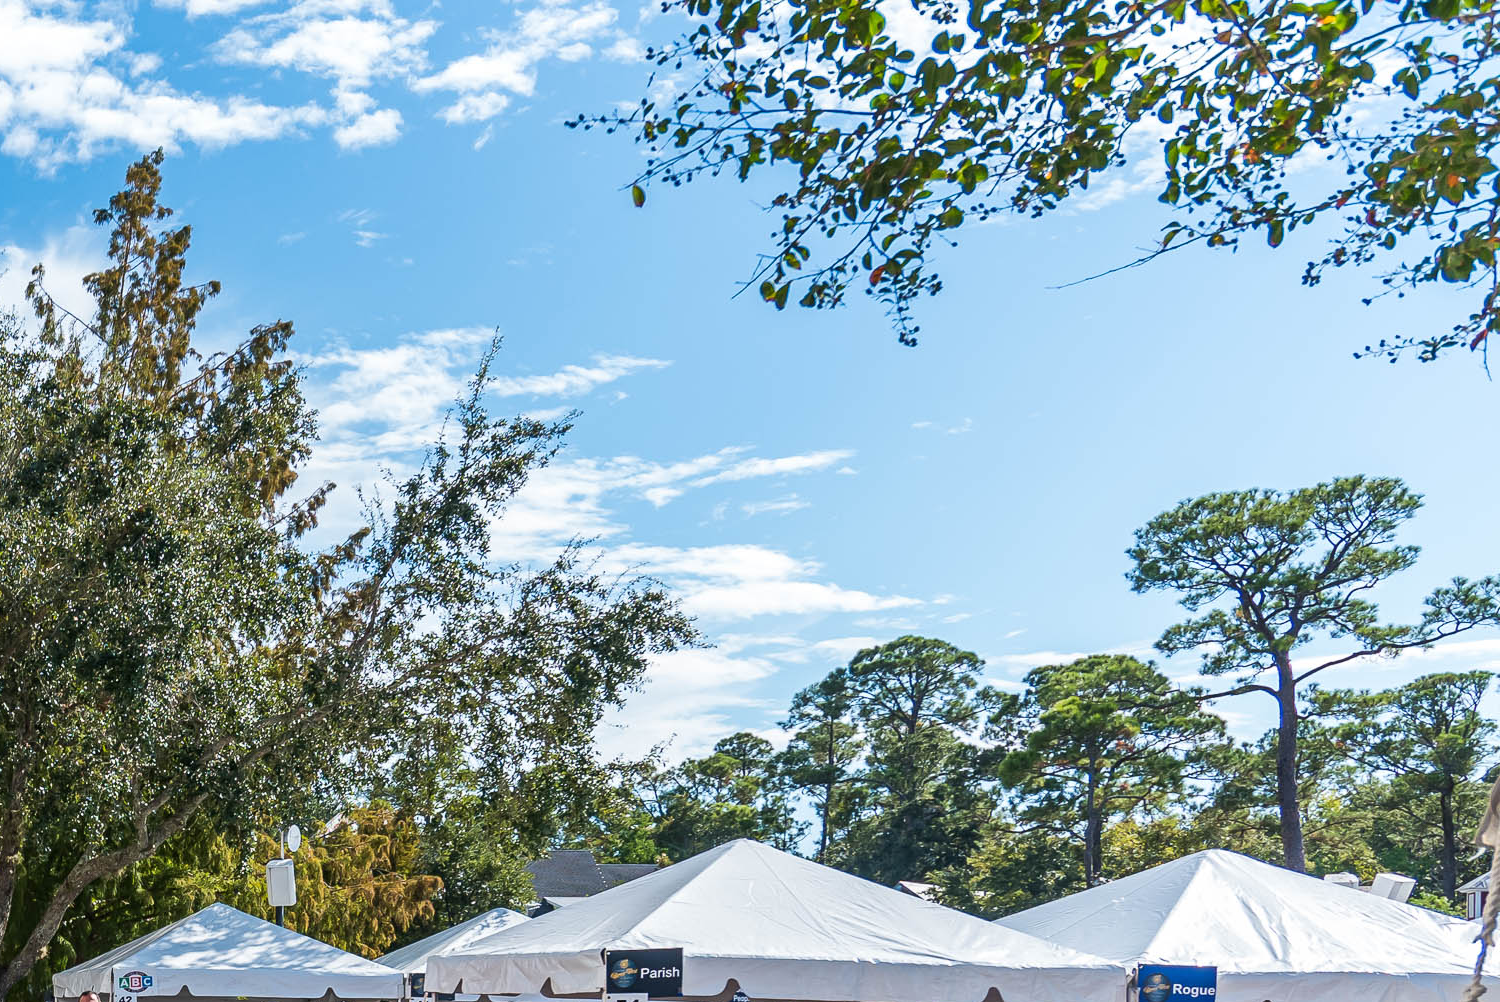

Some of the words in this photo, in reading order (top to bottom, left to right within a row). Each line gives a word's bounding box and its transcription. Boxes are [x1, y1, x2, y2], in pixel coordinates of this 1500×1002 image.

[640, 966, 680, 979] Parish
[119, 976, 152, 988] ABC
[1172, 983, 1216, 998] Rogue
